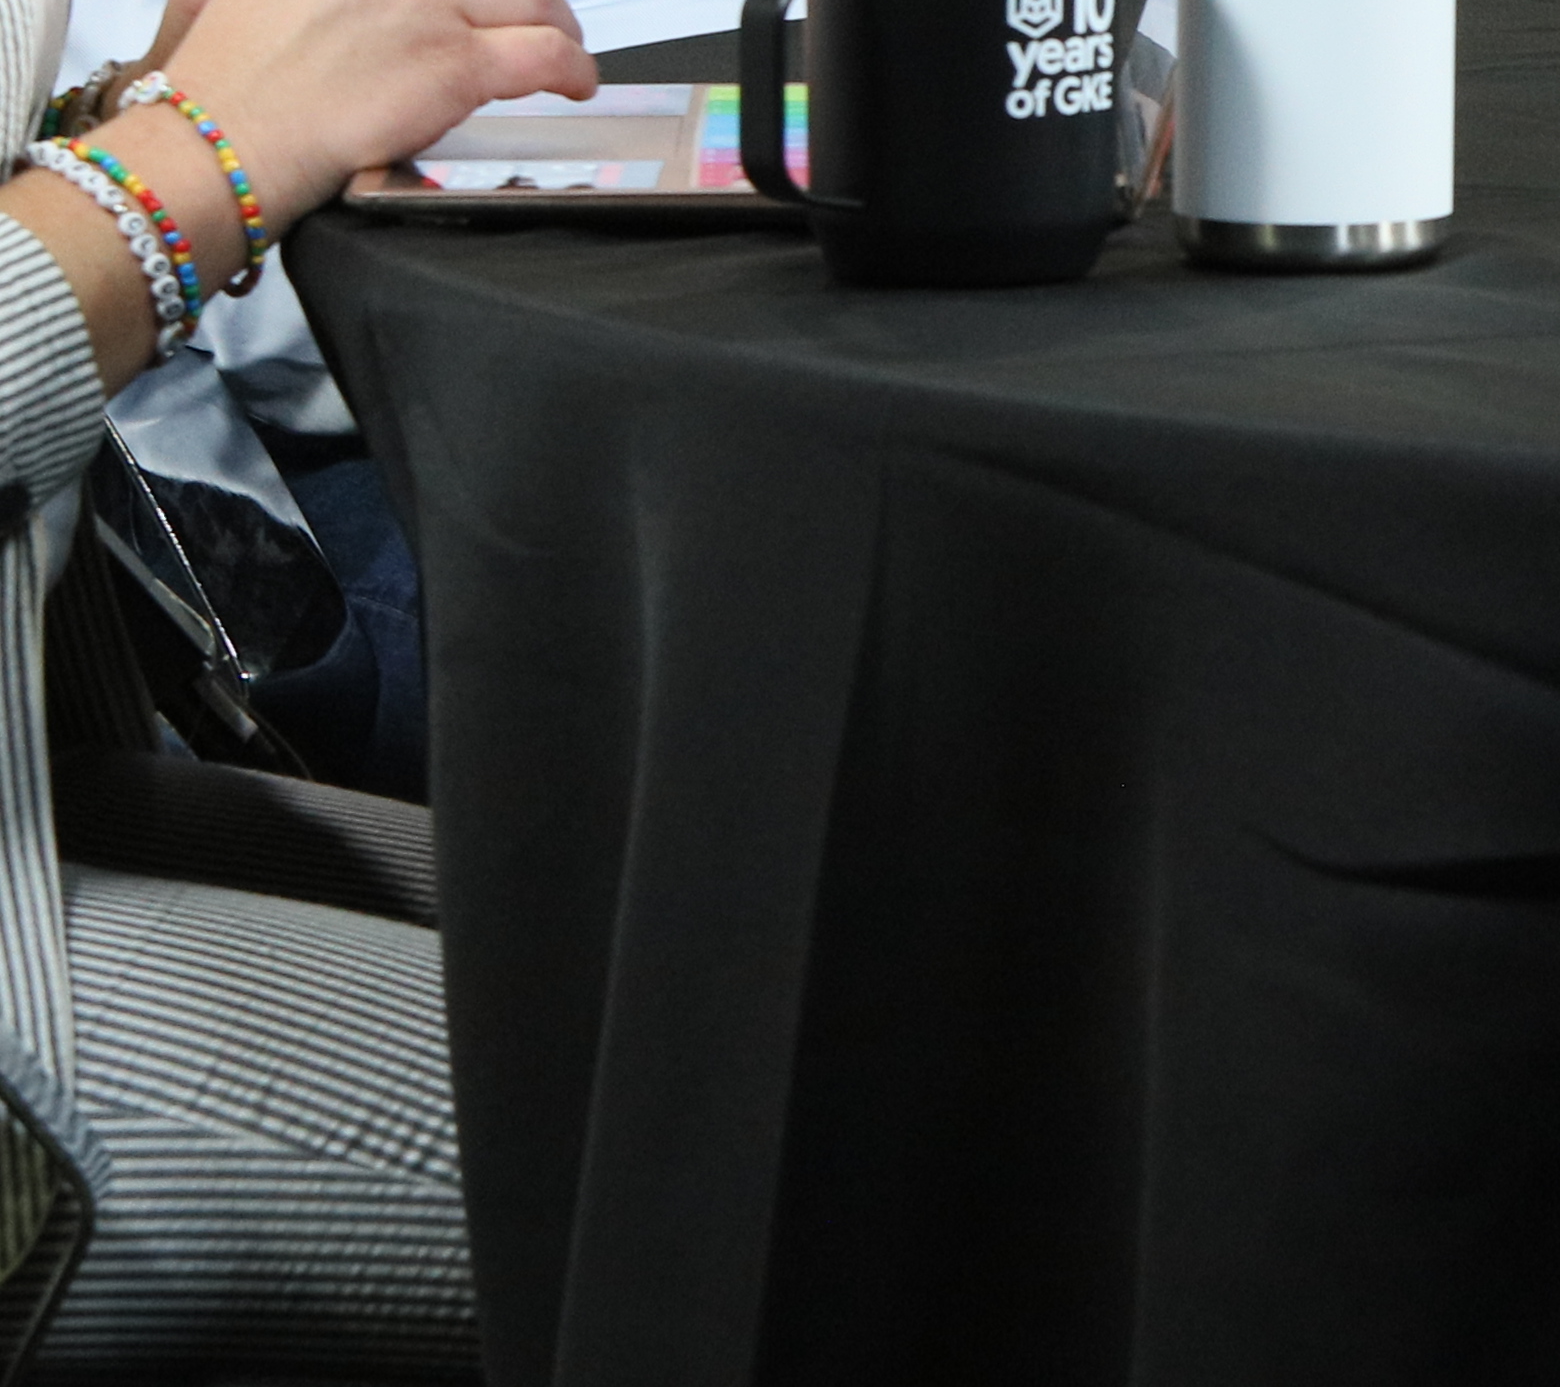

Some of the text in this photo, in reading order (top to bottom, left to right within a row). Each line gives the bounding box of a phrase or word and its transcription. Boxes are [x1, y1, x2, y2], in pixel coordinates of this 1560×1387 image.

[1006, 32, 1115, 89] years
[1005, 71, 1114, 120] of GKE
